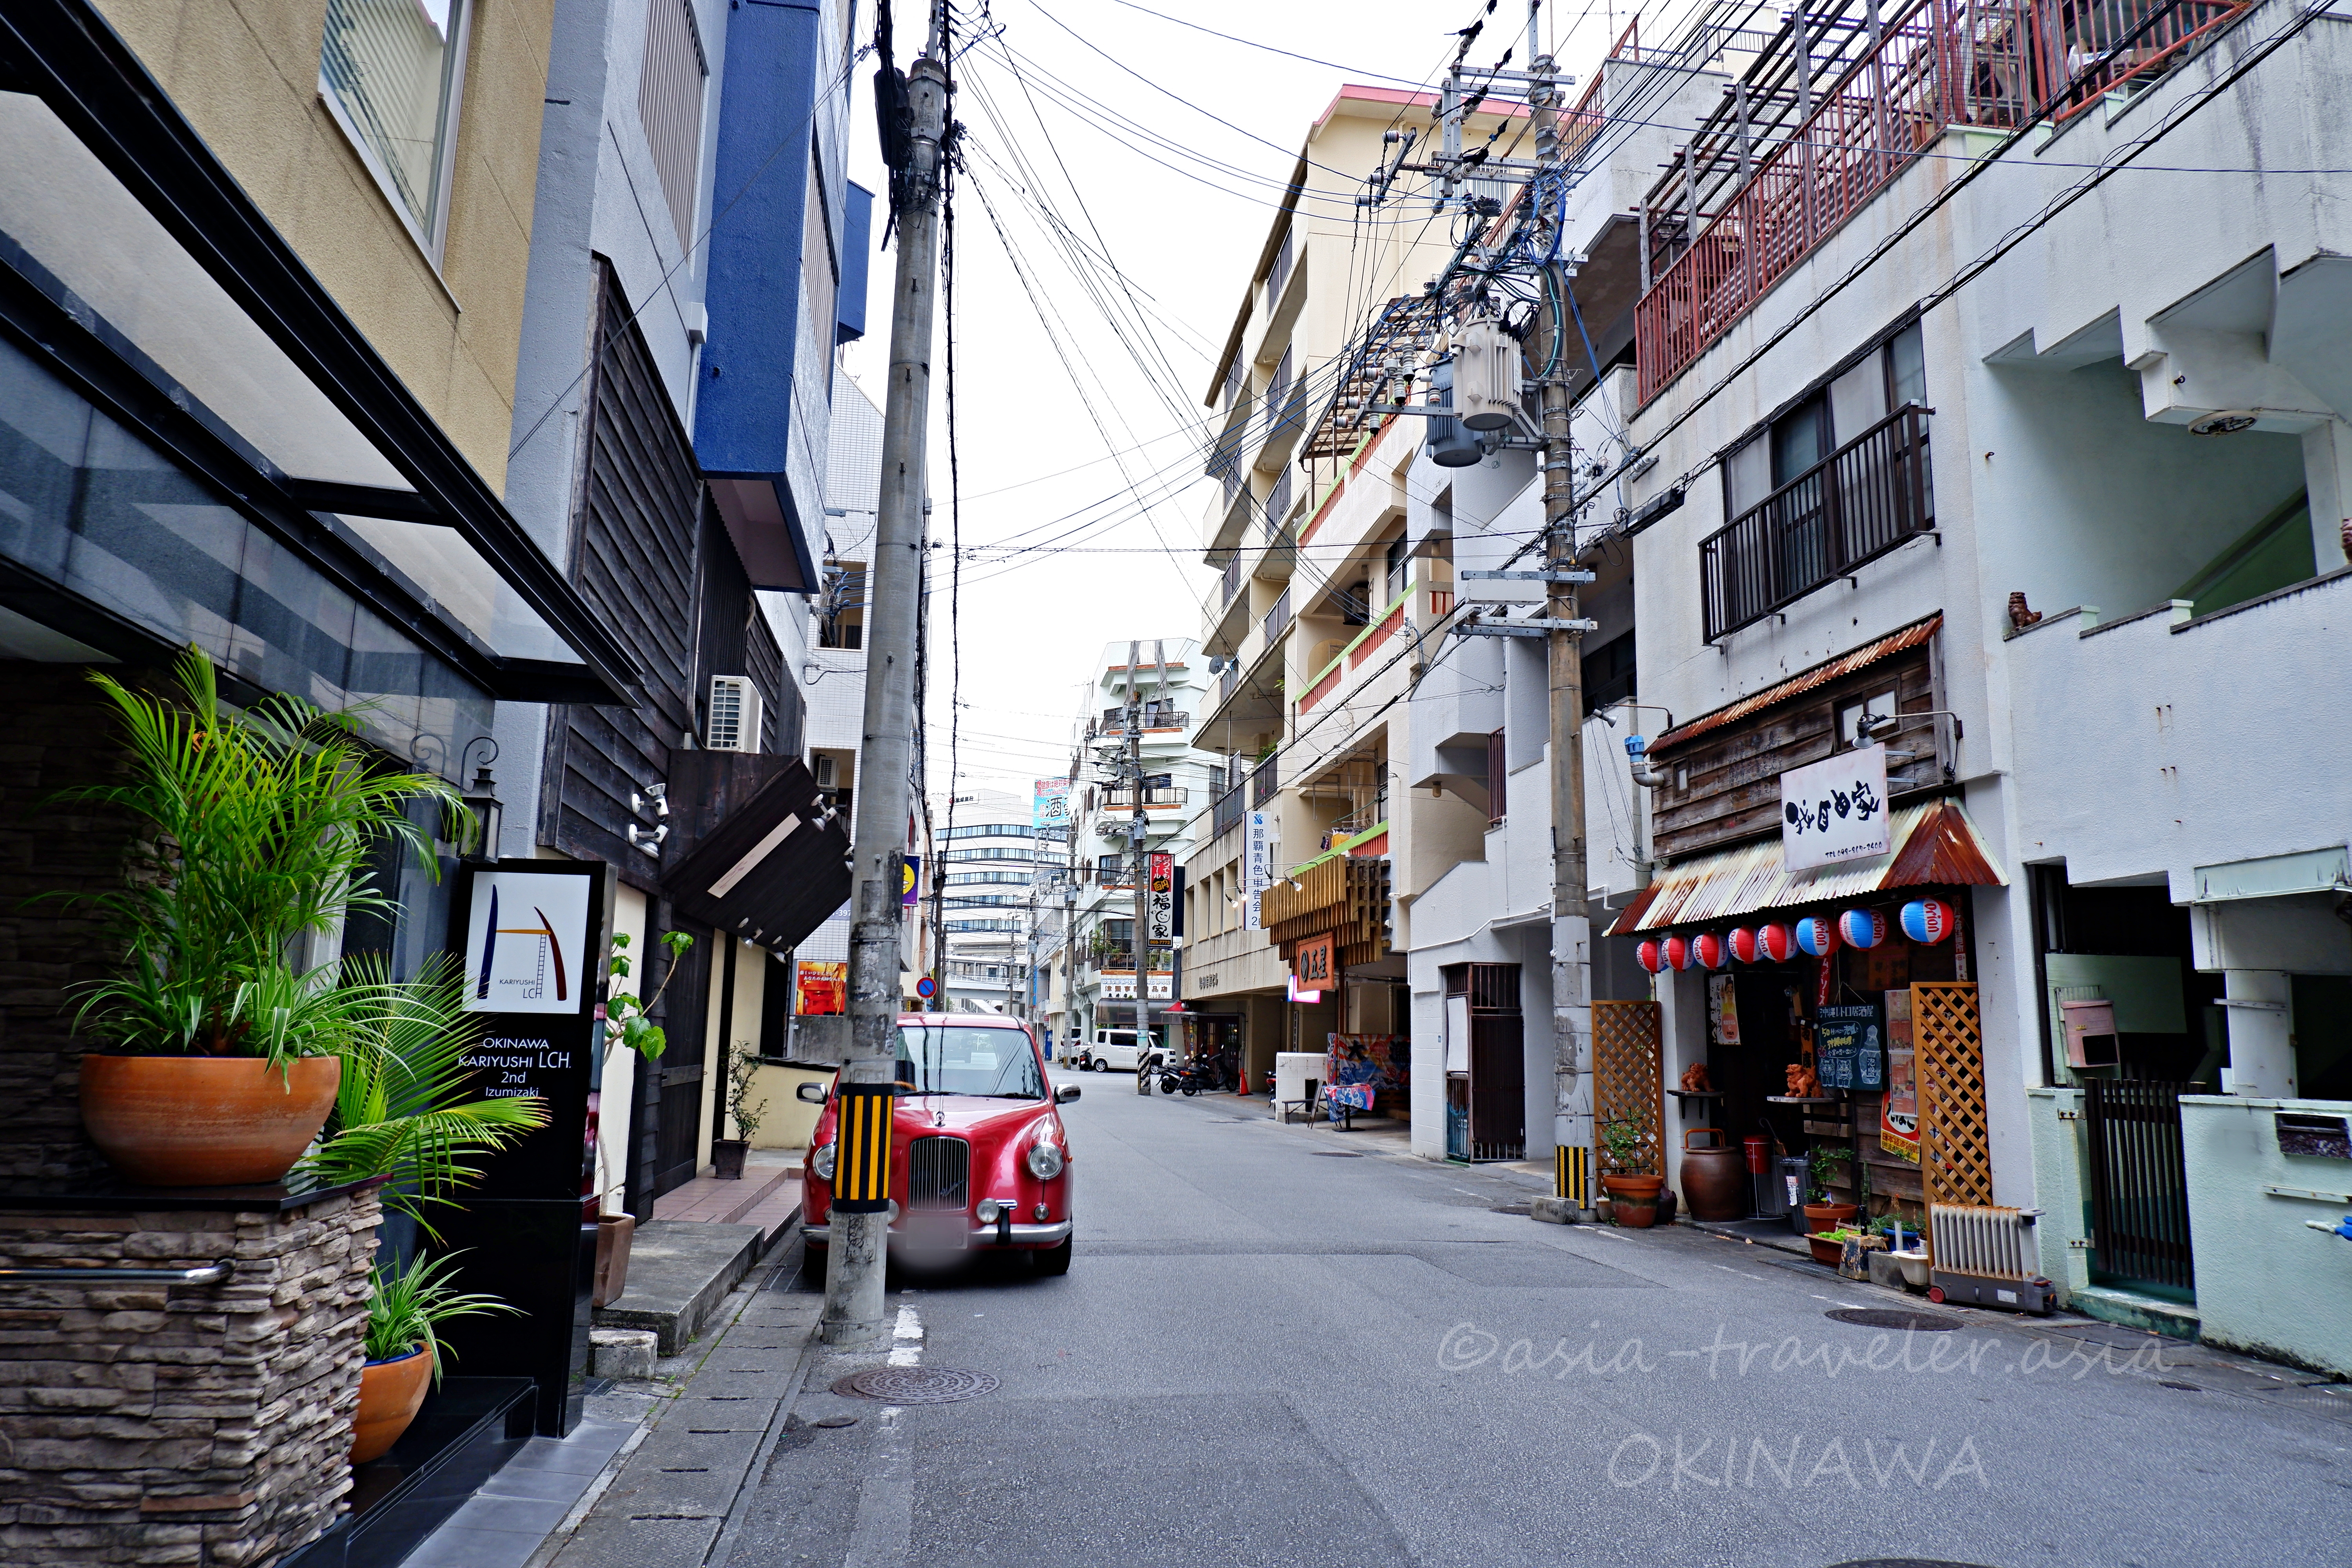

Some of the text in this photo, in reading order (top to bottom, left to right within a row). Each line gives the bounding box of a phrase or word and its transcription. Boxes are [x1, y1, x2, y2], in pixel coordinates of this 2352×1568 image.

[1837, 841, 1882, 857] 098-867-2400
[1153, 855, 1161, 879] 生ビール
[1252, 829, 1263, 912] 那覇青色申告会
[1153, 879, 1170, 891] 百円
[1871, 911, 1885, 939] Orion
[1924, 903, 1941, 933] Orion
[1759, 928, 1768, 952] Orion
[1815, 920, 1829, 946] Orion
[1309, 945, 1327, 980] 五星
[1820, 1005, 1873, 1018] 沖縄レトロ居酒屋
[483, 1037, 550, 1049] OKINAWA
[458, 1055, 533, 1069] KARIYUSHI
[1867, 1058, 1877, 1077] 泡盛
[501, 1071, 526, 1084] 2nd
[485, 1086, 539, 1098] Izumizaki
